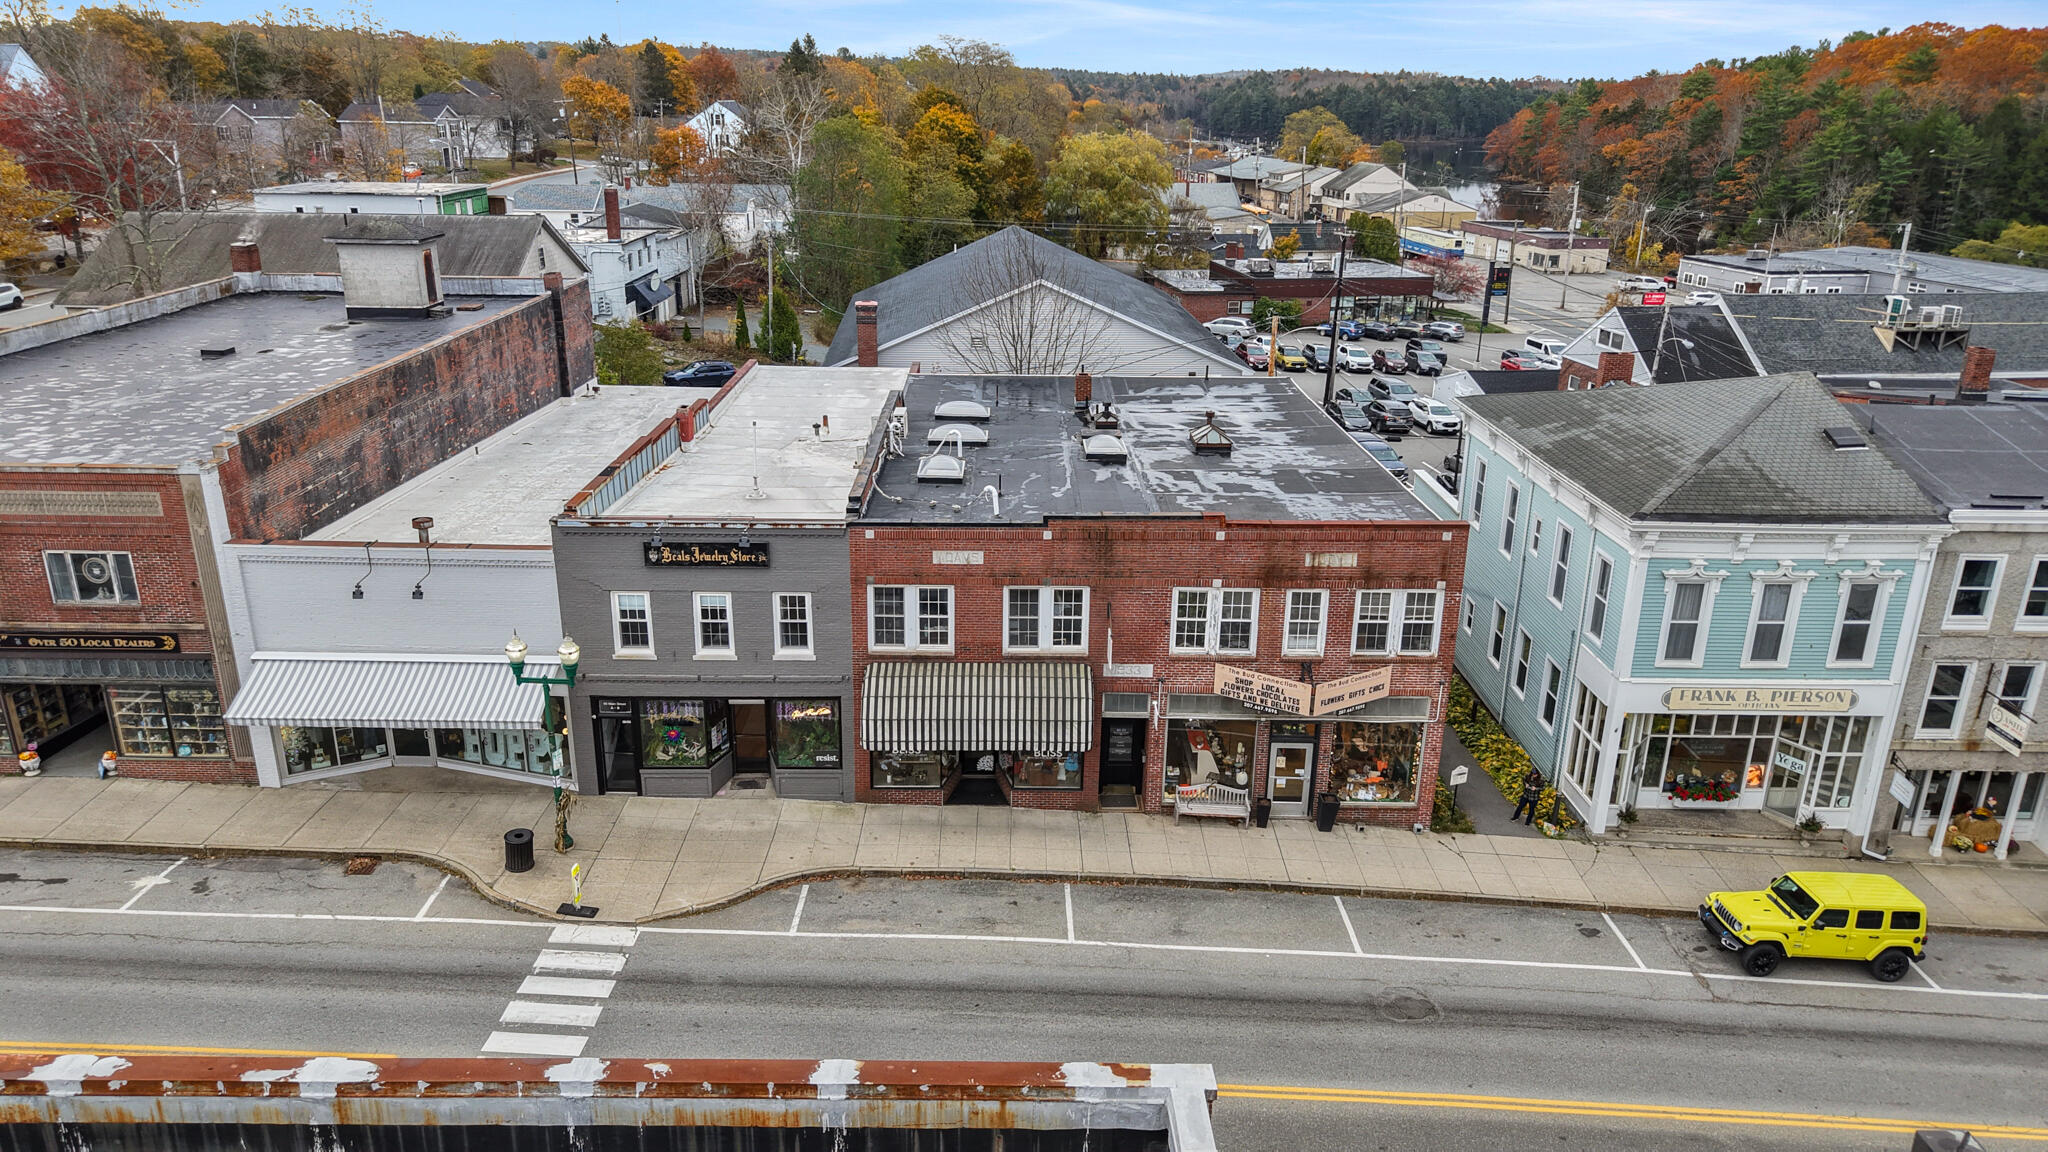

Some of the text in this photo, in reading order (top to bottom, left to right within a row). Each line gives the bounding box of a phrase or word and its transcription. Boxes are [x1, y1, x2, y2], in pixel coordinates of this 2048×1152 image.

[660, 546, 691, 563] Beals
[691, 547, 729, 565] Jewelry
[728, 548, 756, 564] Store
[59, 638, 78, 647] 50
[1228, 667, 1240, 675] The
[1257, 674, 1298, 689] Connection
[1235, 677, 1286, 696] SHOP LOCAL
[1327, 681, 1337, 689] The
[1350, 671, 1382, 683] Connection
[1220, 688, 1300, 713] GIFTS AND WE DELIVER
[1223, 681, 1301, 706] FLOWERS CHOCOLATES
[1320, 694, 1345, 707] FLOWERS
[1348, 688, 1366, 699] GIFTS
[1679, 690, 1847, 703] FRANK B. PIERSON
[816, 754, 839, 762] resist.
